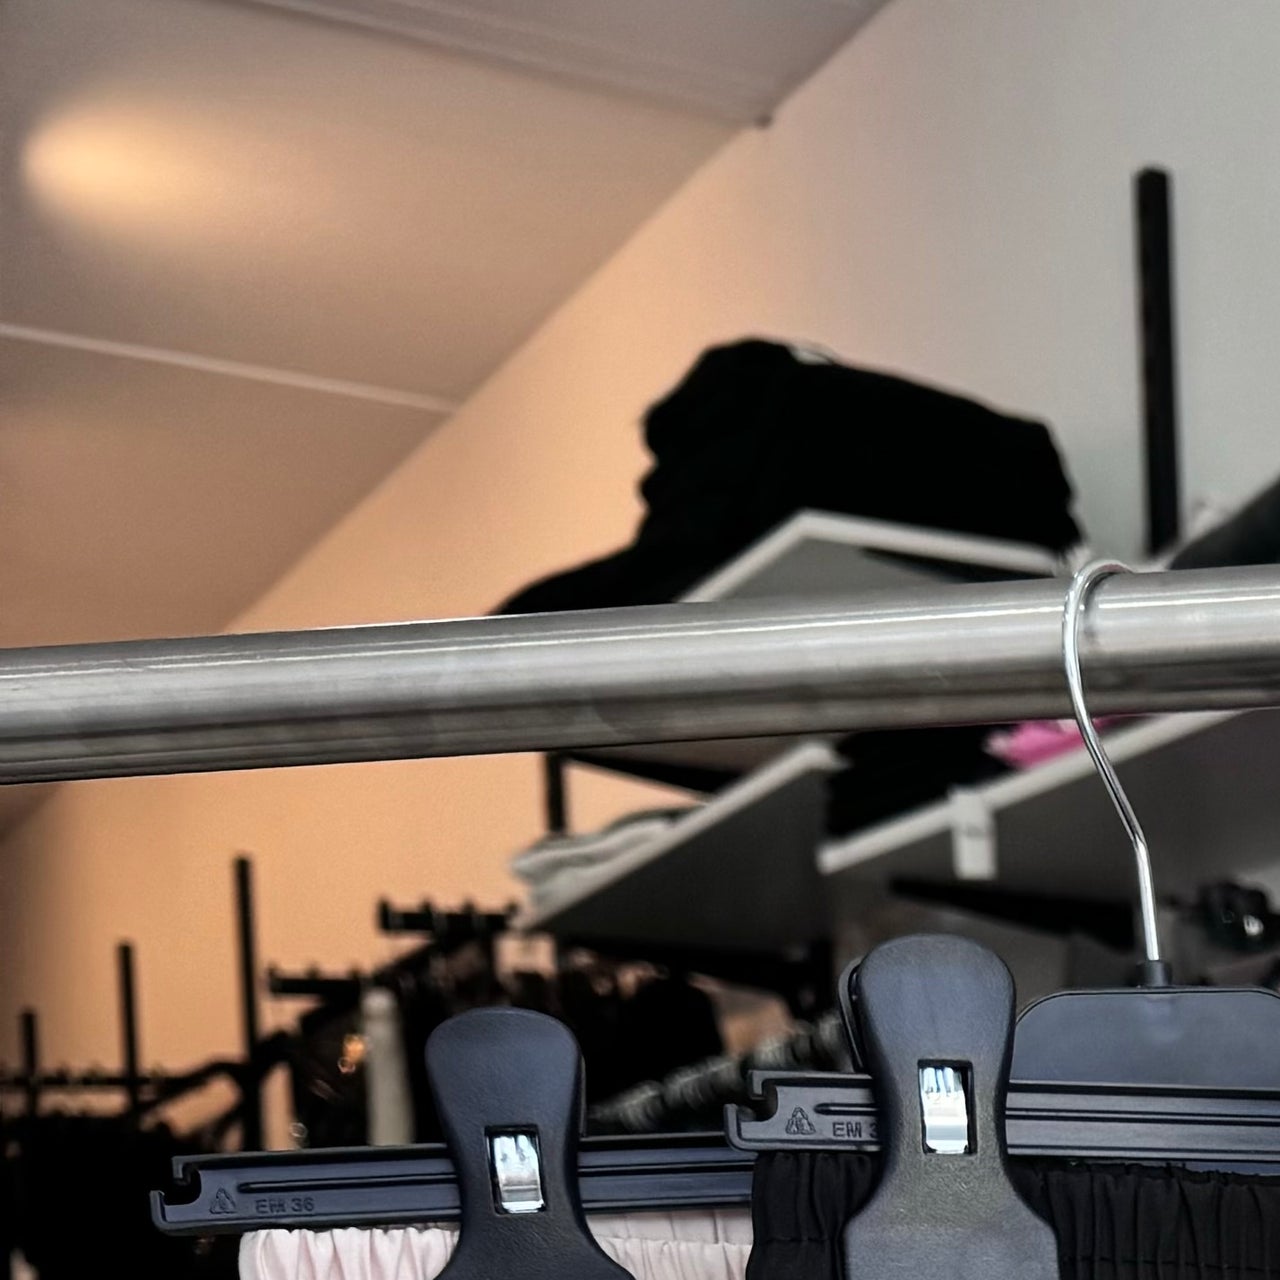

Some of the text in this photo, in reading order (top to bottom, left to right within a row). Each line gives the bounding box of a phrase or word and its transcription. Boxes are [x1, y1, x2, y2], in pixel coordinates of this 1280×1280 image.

[832, 1121, 880, 1139] EM 3
[291, 1197, 315, 1213] 36
